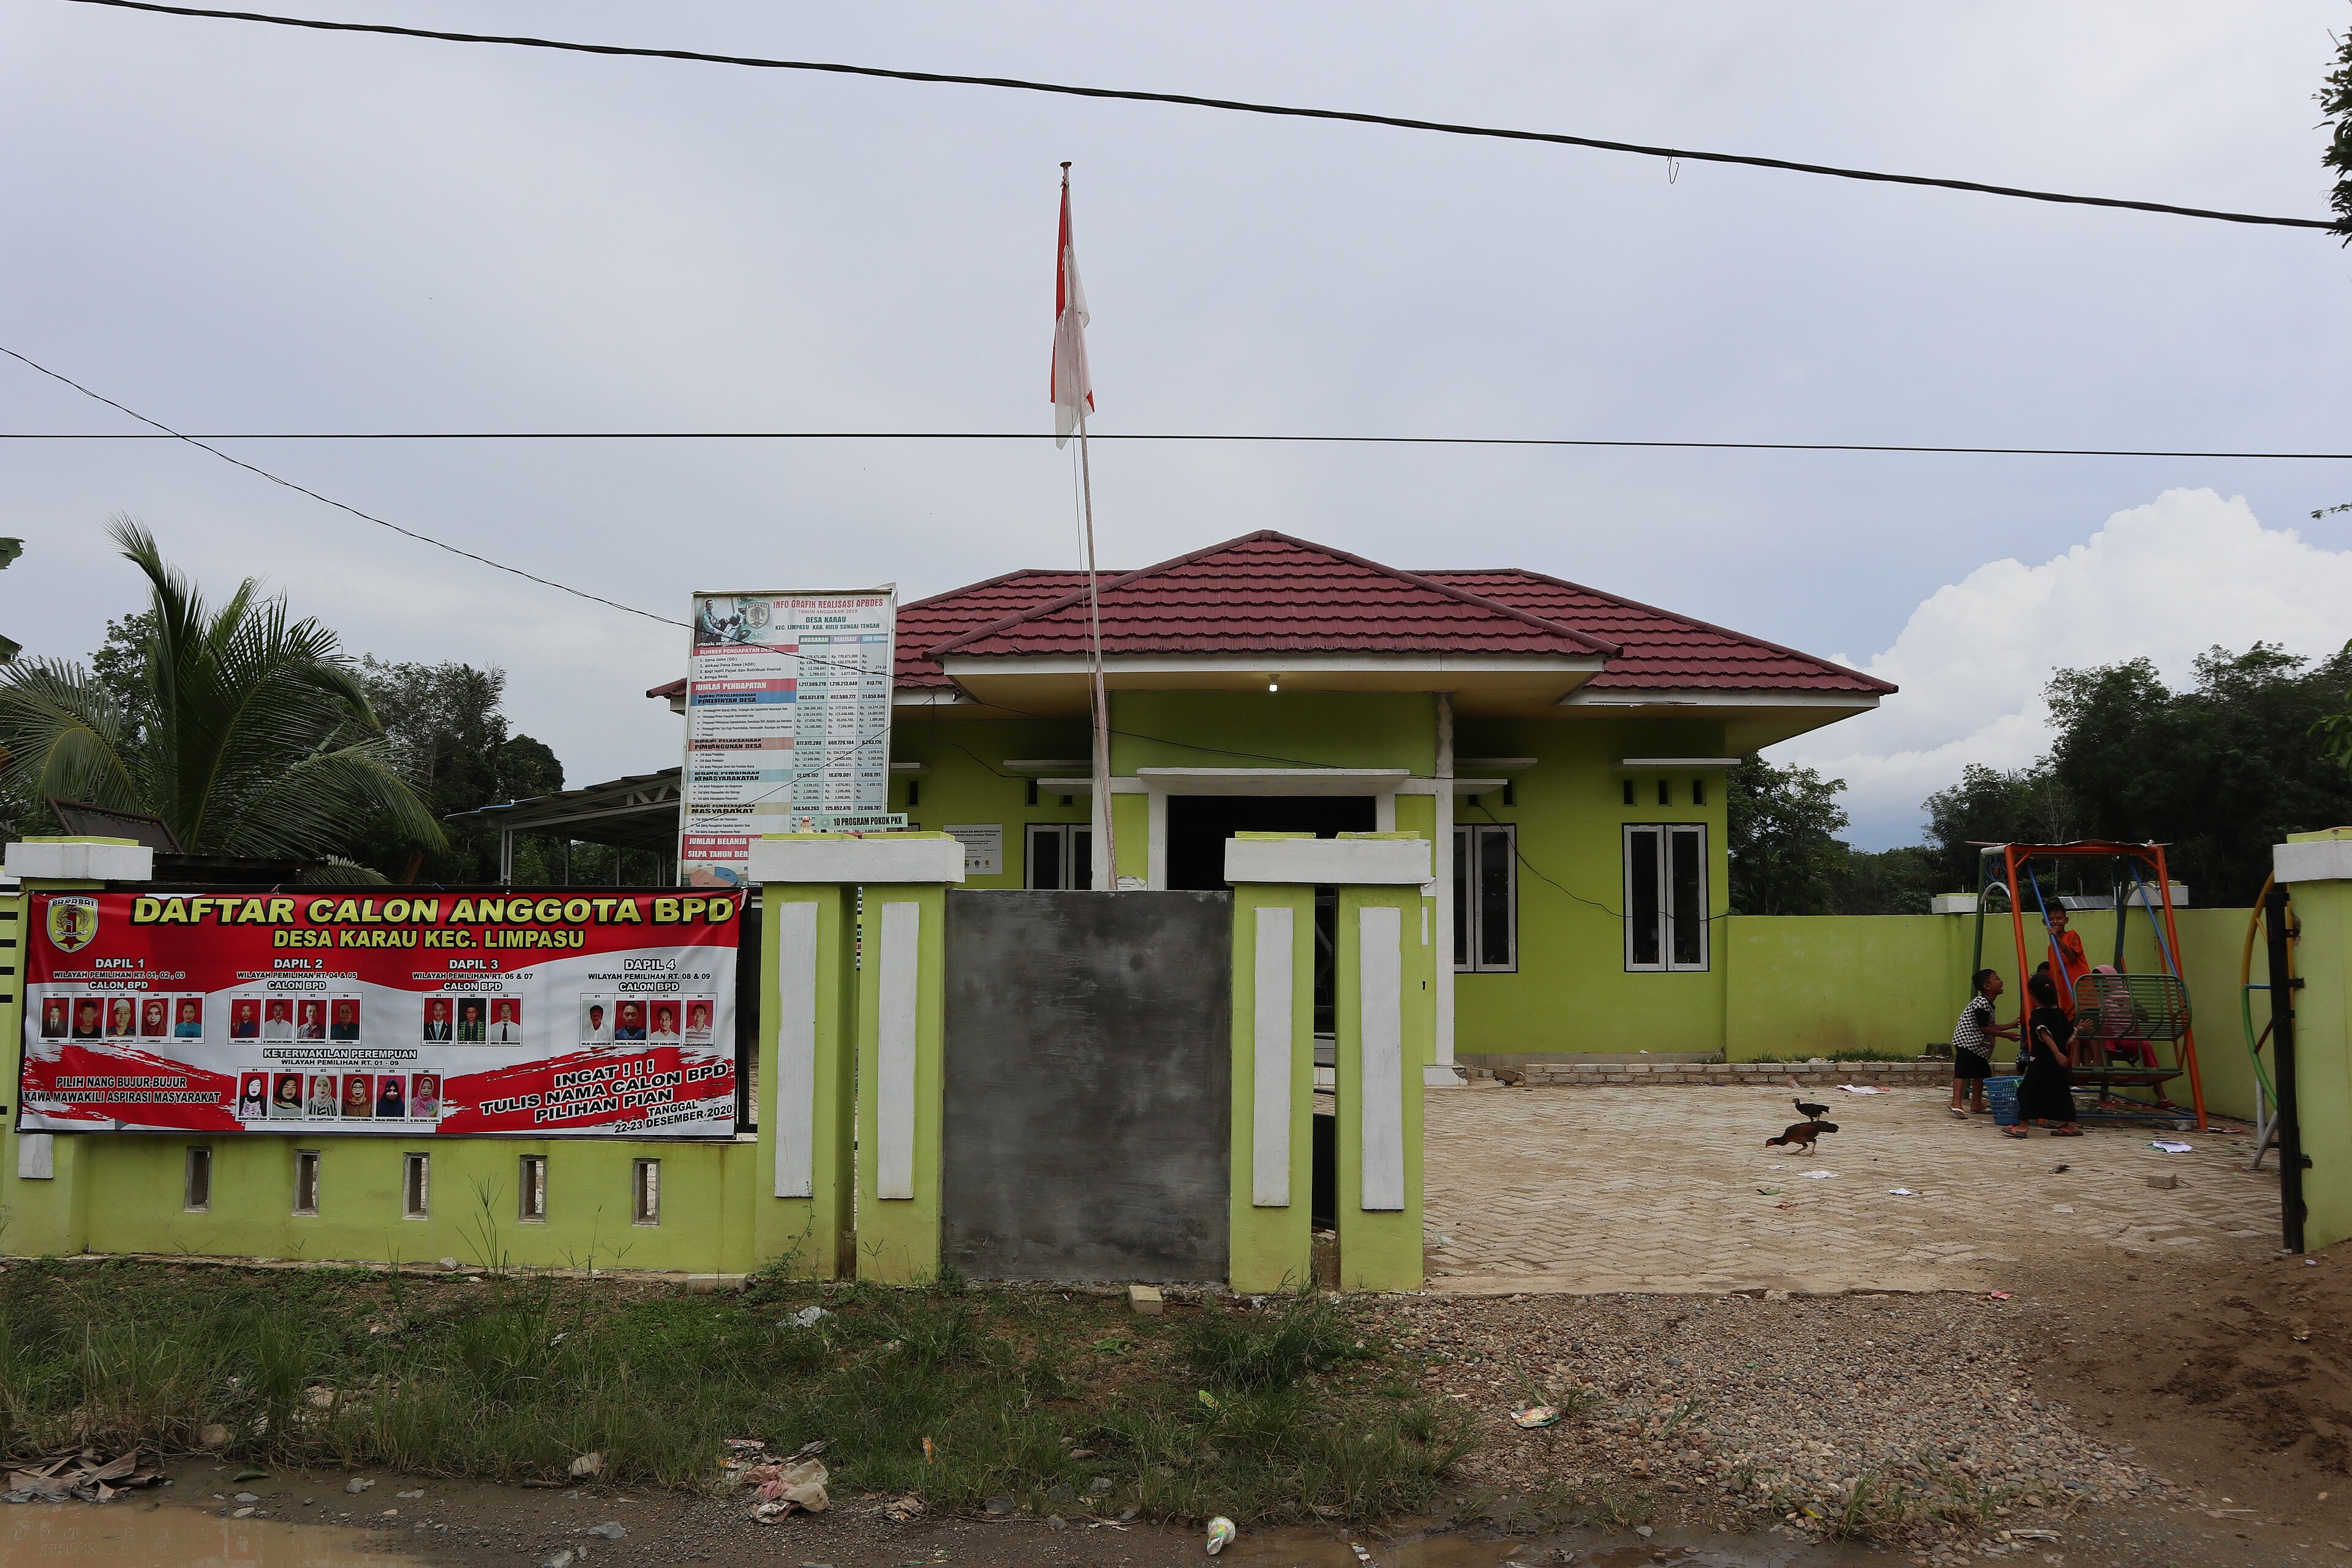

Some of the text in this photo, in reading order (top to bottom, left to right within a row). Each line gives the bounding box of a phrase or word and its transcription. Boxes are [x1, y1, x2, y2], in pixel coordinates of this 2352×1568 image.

[791, 600, 816, 608] GRAFIK
[818, 600, 854, 608] REALISASI
[856, 598, 883, 607] APBDES
[833, 816, 903, 826] 10 PROGRAM POKOK PKK
[134, 898, 734, 923] DAFTAR CALON ANGGOTA BPD
[274, 930, 584, 948] DESA KARAU KEC. LIMPASU
[95, 959, 145, 968] DAPIL 1
[274, 959, 323, 969] DAPIL 2
[449, 959, 499, 970] DAPIL 3
[624, 959, 676, 970] DAPIL 4
[89, 981, 149, 990] CALON BPD
[267, 981, 326, 990] CALON BPD
[443, 982, 503, 991] CALON BPD
[619, 982, 679, 992] CALON BPD
[263, 1049, 418, 1059] KETERWAKILAN PEREMPUAN
[555, 1065, 618, 1087] INGAT
[56, 1076, 186, 1088] PILIH NANG BUJUR-BUJUR
[480, 1063, 728, 1115] TULIS NAMA CALON BPD
[24, 1091, 221, 1103] KAWA MAWAKILI ASPIRASI MASYARAKAT
[535, 1088, 673, 1122] PILIHAN PIAN
[647, 1100, 698, 1117] TANGGAL
[614, 1104, 733, 1133] 22-23 DESEMBER 2020
